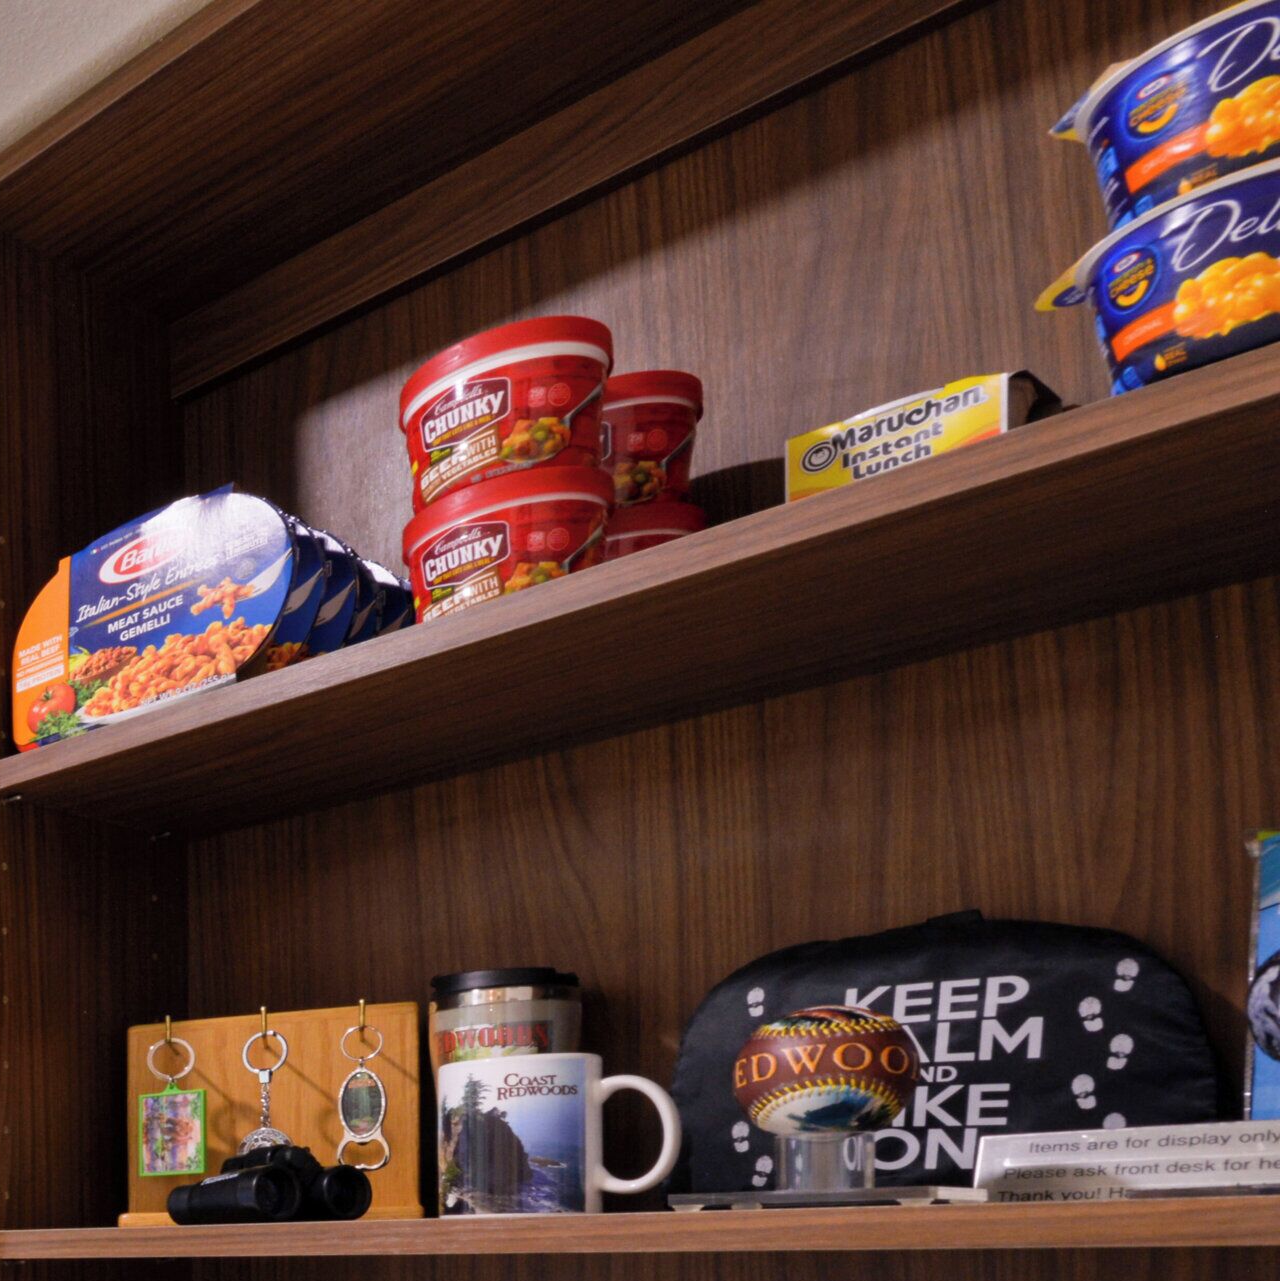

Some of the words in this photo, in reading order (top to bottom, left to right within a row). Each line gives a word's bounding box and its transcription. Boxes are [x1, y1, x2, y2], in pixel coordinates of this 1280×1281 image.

[424, 391, 505, 444] CHUNKY
[832, 384, 985, 452] Maruchan
[467, 435, 496, 456] WITH
[842, 421, 944, 469] Instant
[852, 444, 932, 480] Lunch
[424, 533, 504, 582] CHUNKY
[76, 573, 161, 624] Italian-Style
[471, 576, 498, 598] WITH
[108, 613, 139, 634] MEAT
[143, 595, 183, 620] SAUCE
[120, 614, 171, 641] GEMELLI
[18, 641, 41, 658] MADE
[42, 635, 63, 650] WITH
[20, 652, 40, 666] REAL
[41, 644, 60, 660] BEEF
[844, 975, 1030, 1024] KEEP
[504, 1073, 557, 1087] COAST
[919, 1065, 958, 1083] ND
[497, 1085, 578, 1100] REDWOODS
[892, 1083, 1010, 1128] IKE
[874, 1128, 978, 1170] ON
[1030, 1140, 1080, 1154] Items
[1087, 1140, 1118, 1151] are
[1125, 1136, 1150, 1149] for
[1157, 1131, 1232, 1149] display
[1239, 1128, 1280, 1146] only
[1004, 1165, 1067, 1180] Please
[1073, 1164, 1107, 1177] ask
[1114, 1162, 1160, 1177] front
[1166, 1160, 1215, 1174] desk
[1223, 1158, 1250, 1172] for
[998, 1189, 1053, 1203] Thank
[1061, 1187, 1101, 1202] you!
